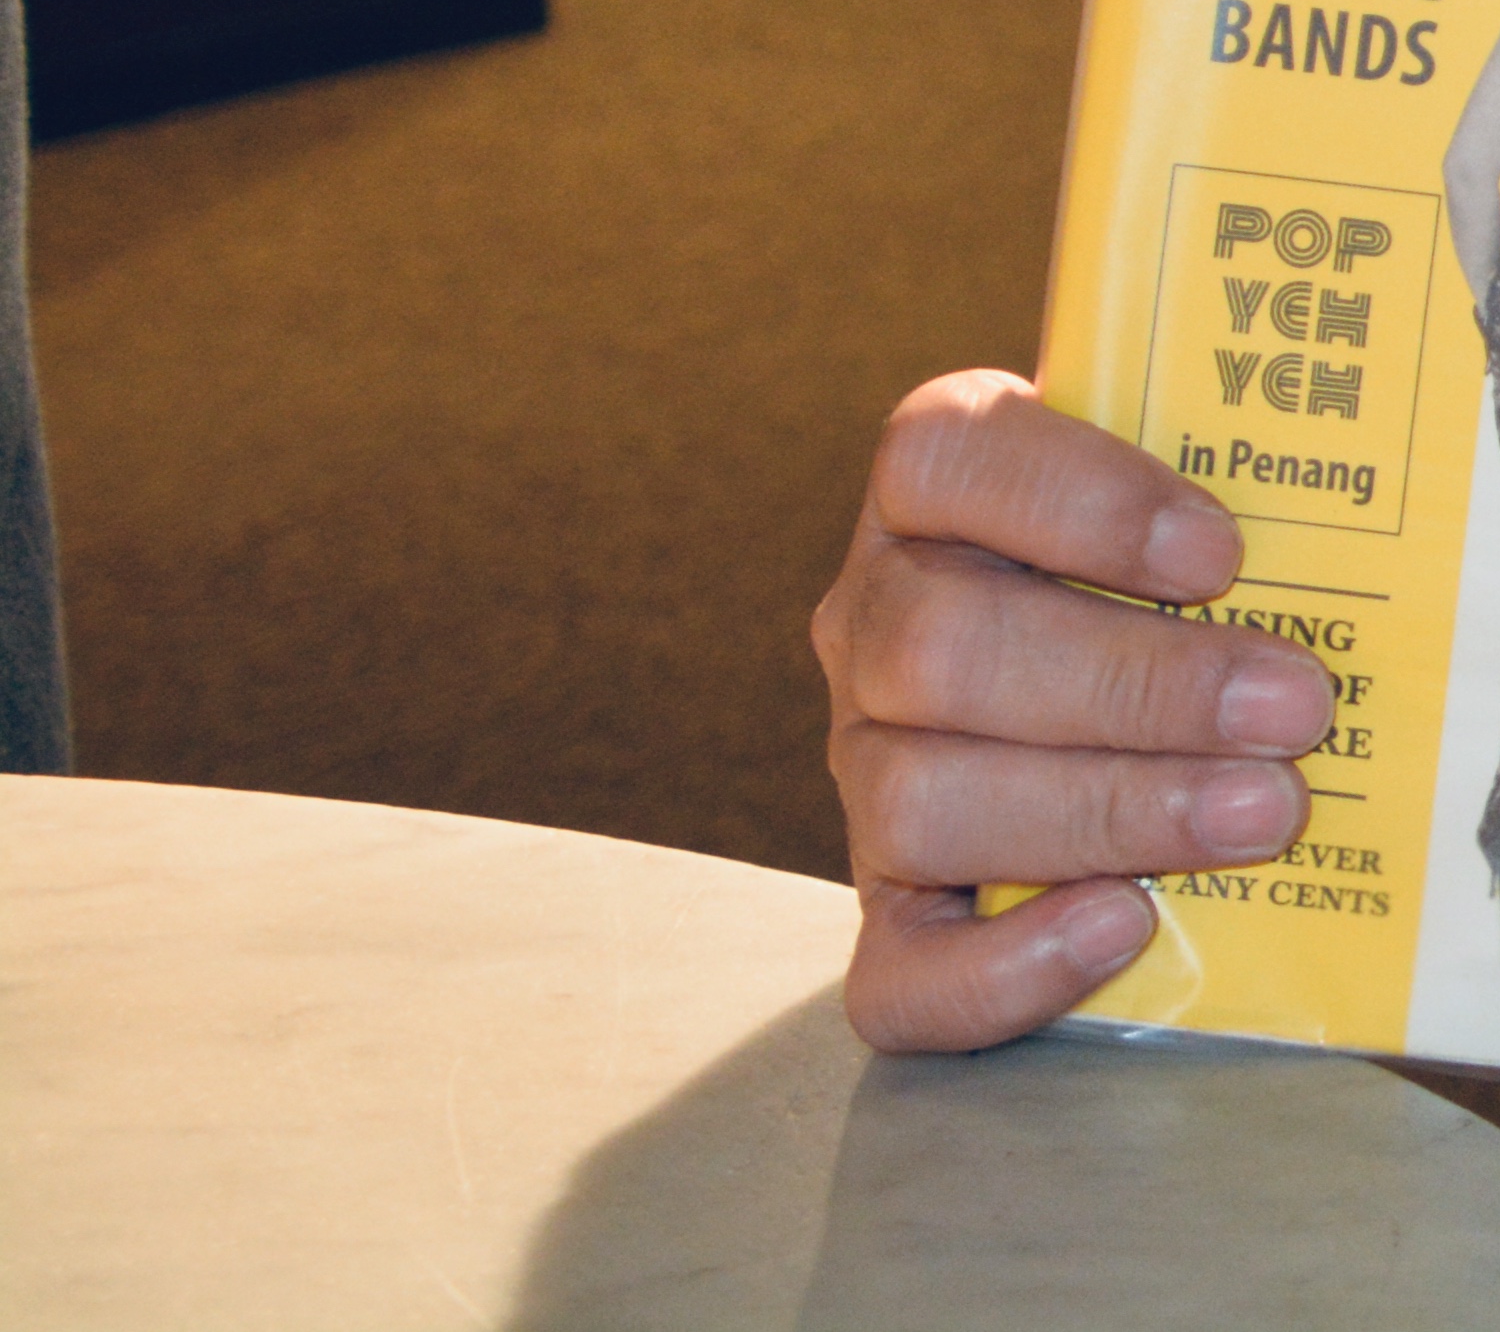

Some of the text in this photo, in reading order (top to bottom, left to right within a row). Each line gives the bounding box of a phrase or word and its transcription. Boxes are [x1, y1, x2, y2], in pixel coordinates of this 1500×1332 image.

[1214, 202, 1391, 273] POP
[1223, 276, 1371, 349] YEH
[1214, 347, 1363, 420] YEH
[1178, 433, 1376, 506] in Penang
[1177, 872, 1259, 902] ANY
[1269, 879, 1391, 917] CENTS
